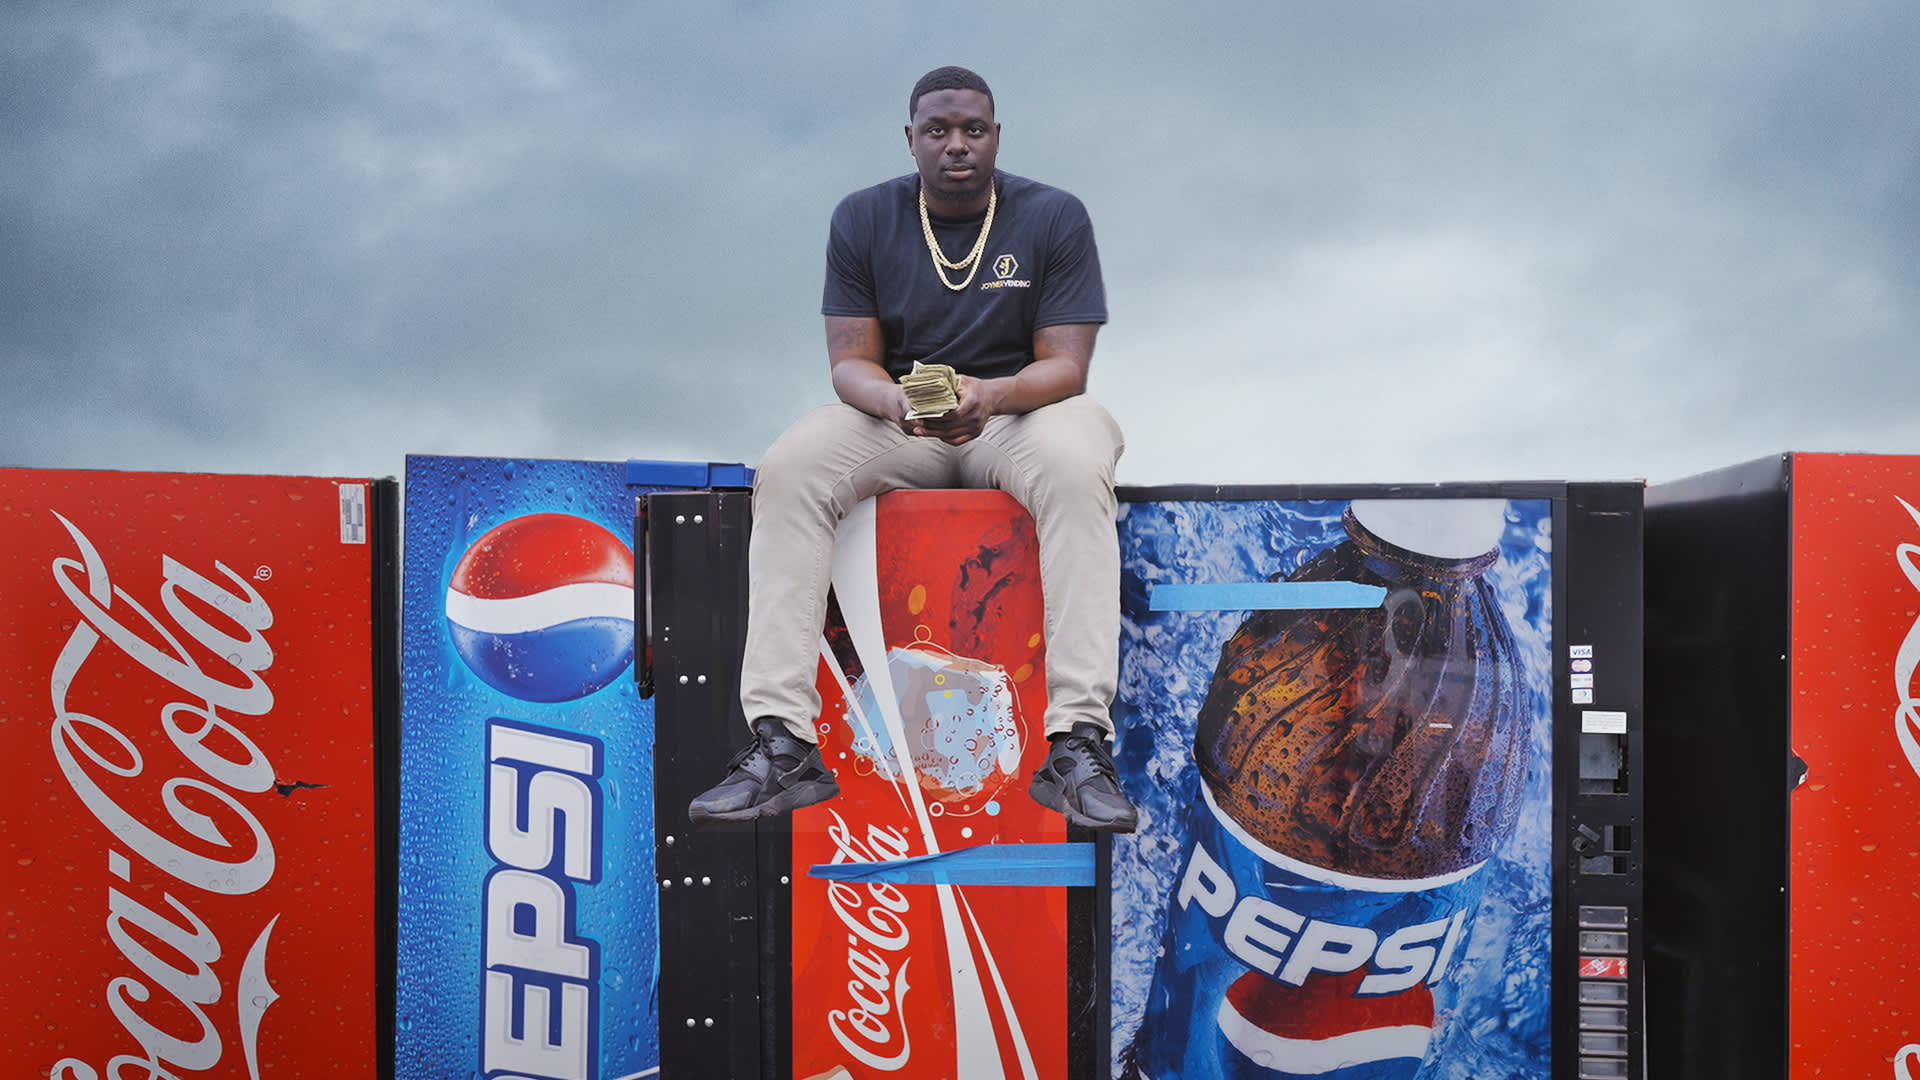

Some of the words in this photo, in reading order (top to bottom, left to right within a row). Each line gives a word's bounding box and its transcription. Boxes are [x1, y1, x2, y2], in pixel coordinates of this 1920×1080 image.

[1573, 648, 1592, 656] VISA
[50, 509, 279, 1080] ca-Cola
[486, 718, 601, 1080] EPSI
[1177, 841, 1466, 996] PEPSI
[827, 807, 911, 1071] Coca-Cola
